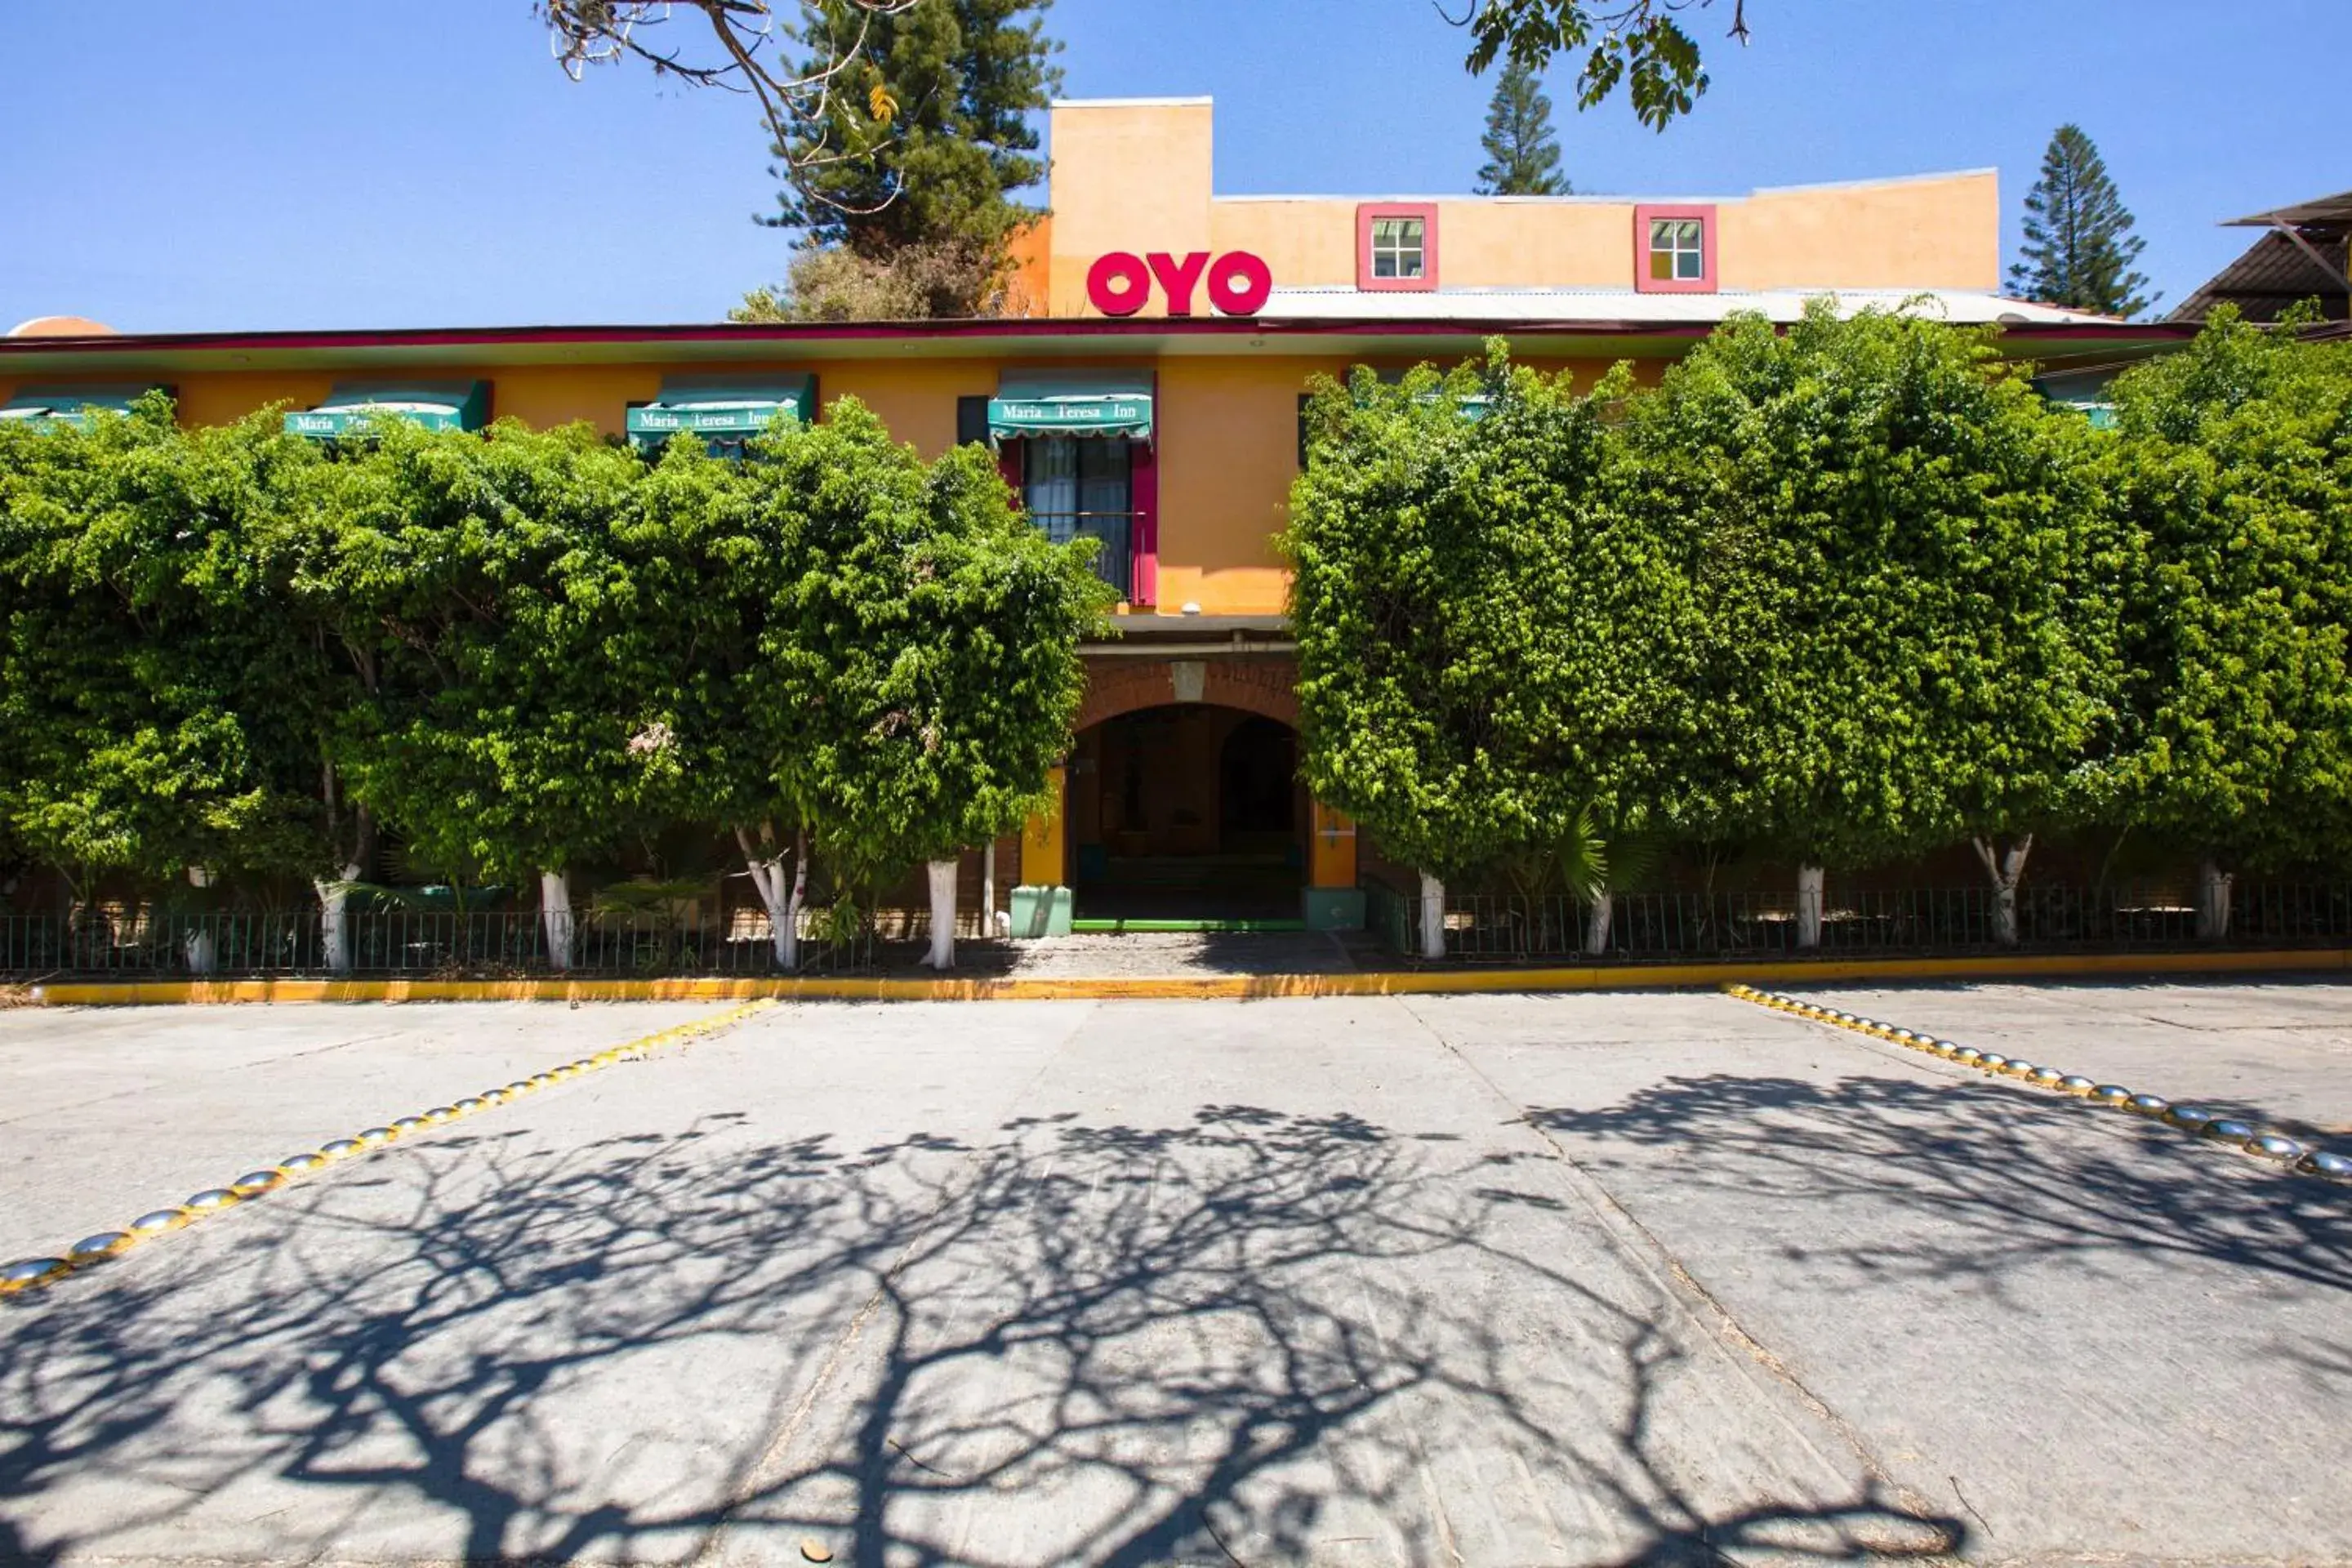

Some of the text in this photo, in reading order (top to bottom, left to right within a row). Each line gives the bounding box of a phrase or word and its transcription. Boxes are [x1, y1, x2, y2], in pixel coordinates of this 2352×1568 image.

[1087, 251, 1272, 317] OYO
[1058, 404, 1101, 418] Teresa
[1114, 404, 1136, 417] Inn
[692, 412, 734, 426] Teresa
